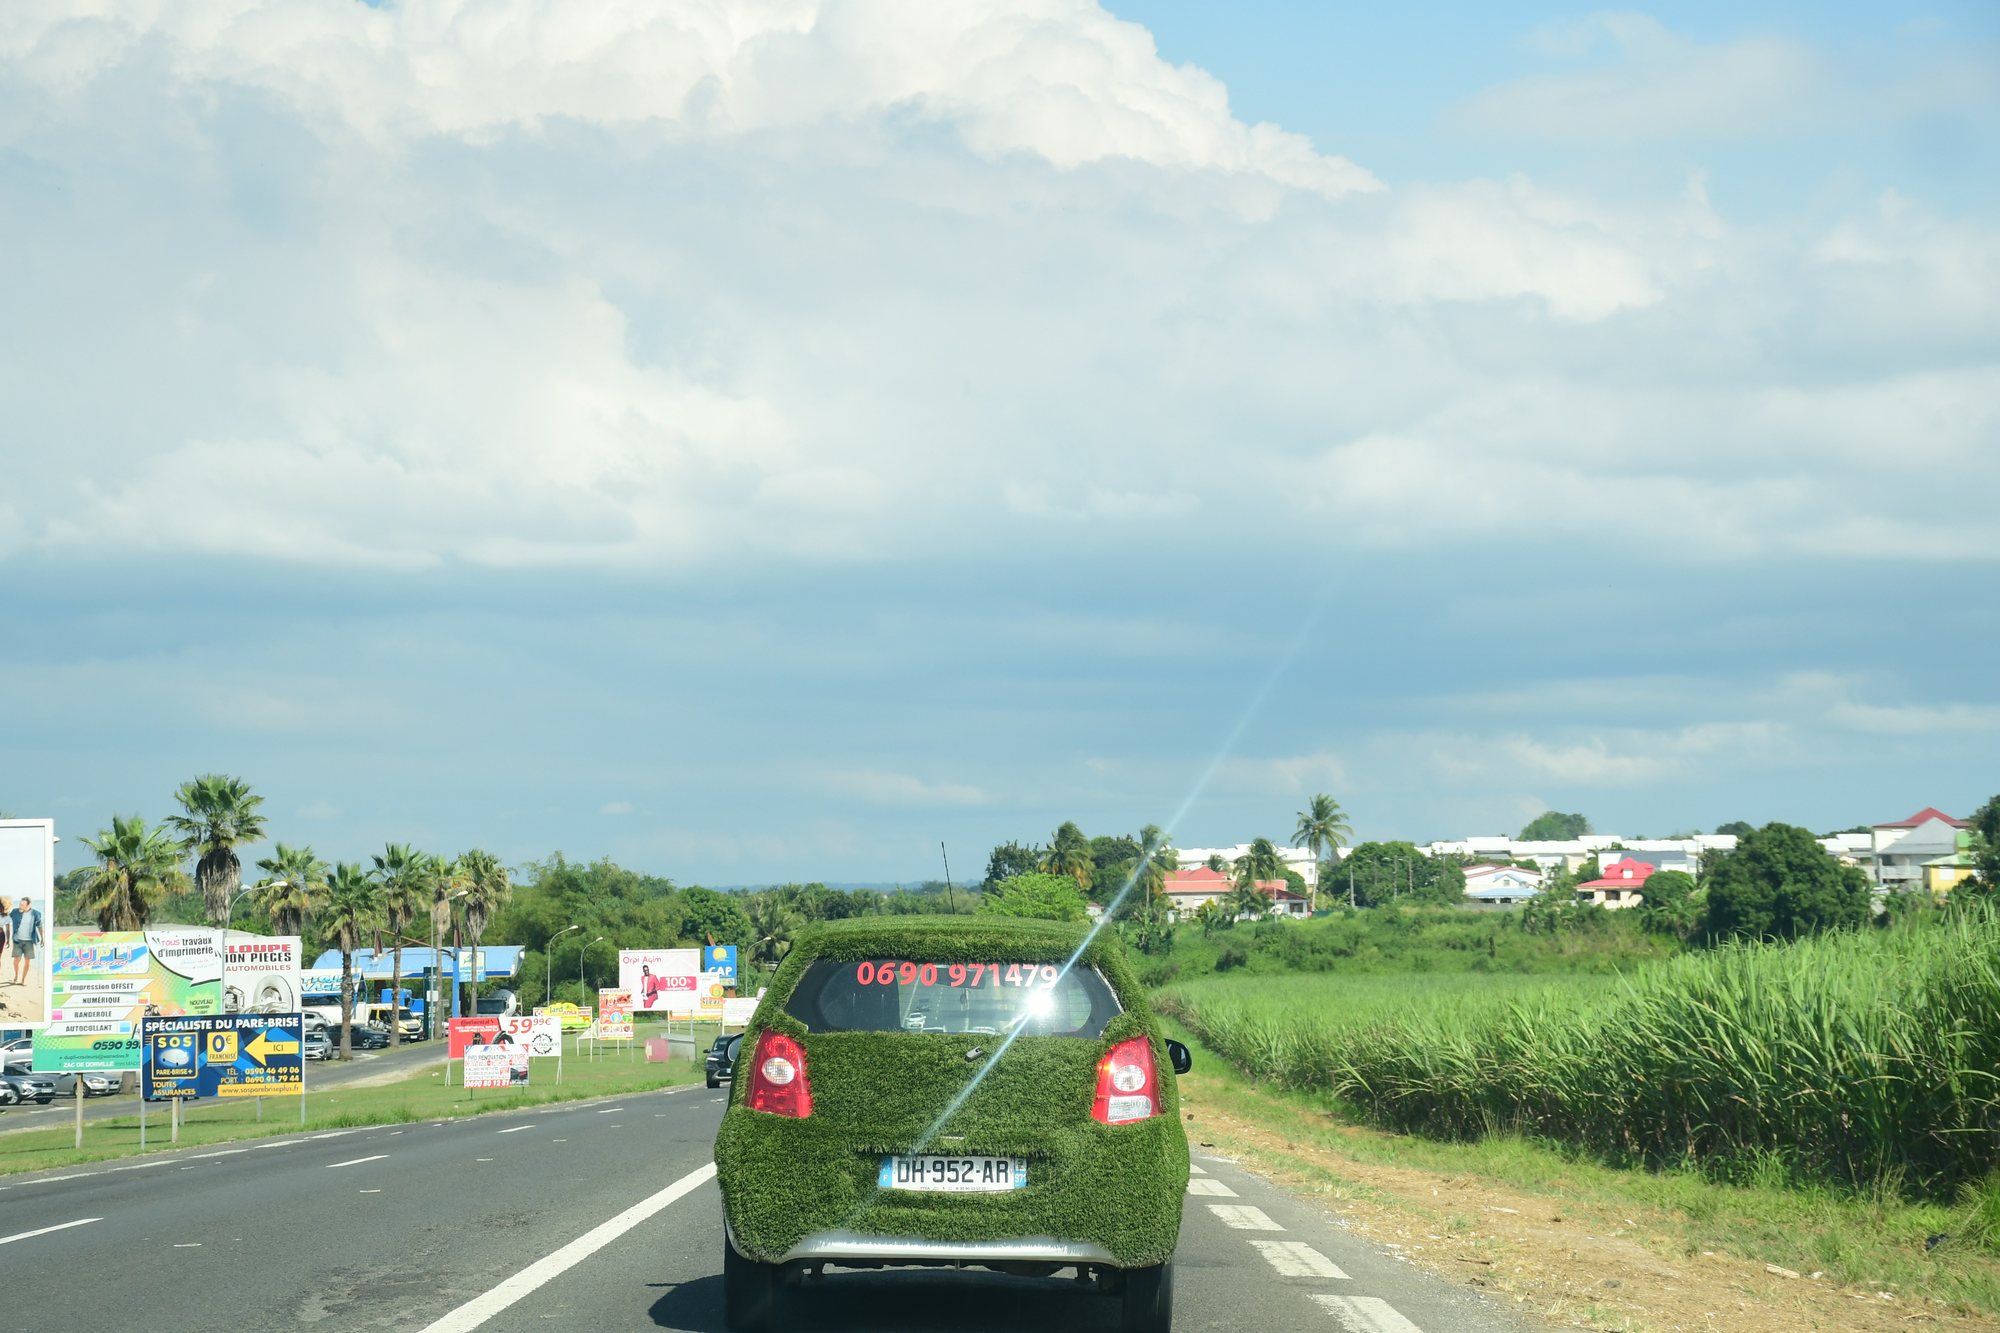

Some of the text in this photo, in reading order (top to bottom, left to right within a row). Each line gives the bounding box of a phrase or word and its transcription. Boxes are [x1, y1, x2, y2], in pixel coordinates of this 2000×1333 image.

[182, 937, 212, 946] travaux
[158, 946, 213, 957] d'imprimerie
[251, 952, 291, 963] PIECES
[622, 956, 640, 964] Orpi
[856, 961, 1058, 989] 0690 971479
[70, 982, 134, 991] Impression OFFSET
[82, 996, 121, 1004] NUMÉRIQUE
[74, 1010, 112, 1018] BANDEROLE
[145, 1017, 299, 1032] SPÉCIALISTE DU PARE-BRISE
[461, 1018, 490, 1026] Continental
[65, 1024, 112, 1032] AUTOCOLLANT
[92, 1040, 141, 1050] 0590 99
[157, 1036, 193, 1049] SOS
[273, 1043, 284, 1052] ICI
[245, 1067, 265, 1075] 0590
[266, 1067, 276, 1075] 46
[278, 1066, 288, 1074] 49
[289, 1066, 300, 1074] 06
[245, 1075, 265, 1083] 0690
[266, 1075, 275, 1083] 91
[289, 1074, 300, 1082] 44
[153, 1088, 195, 1096] ASSURANCES
[897, 1160, 1009, 1183] DH-952-AR
